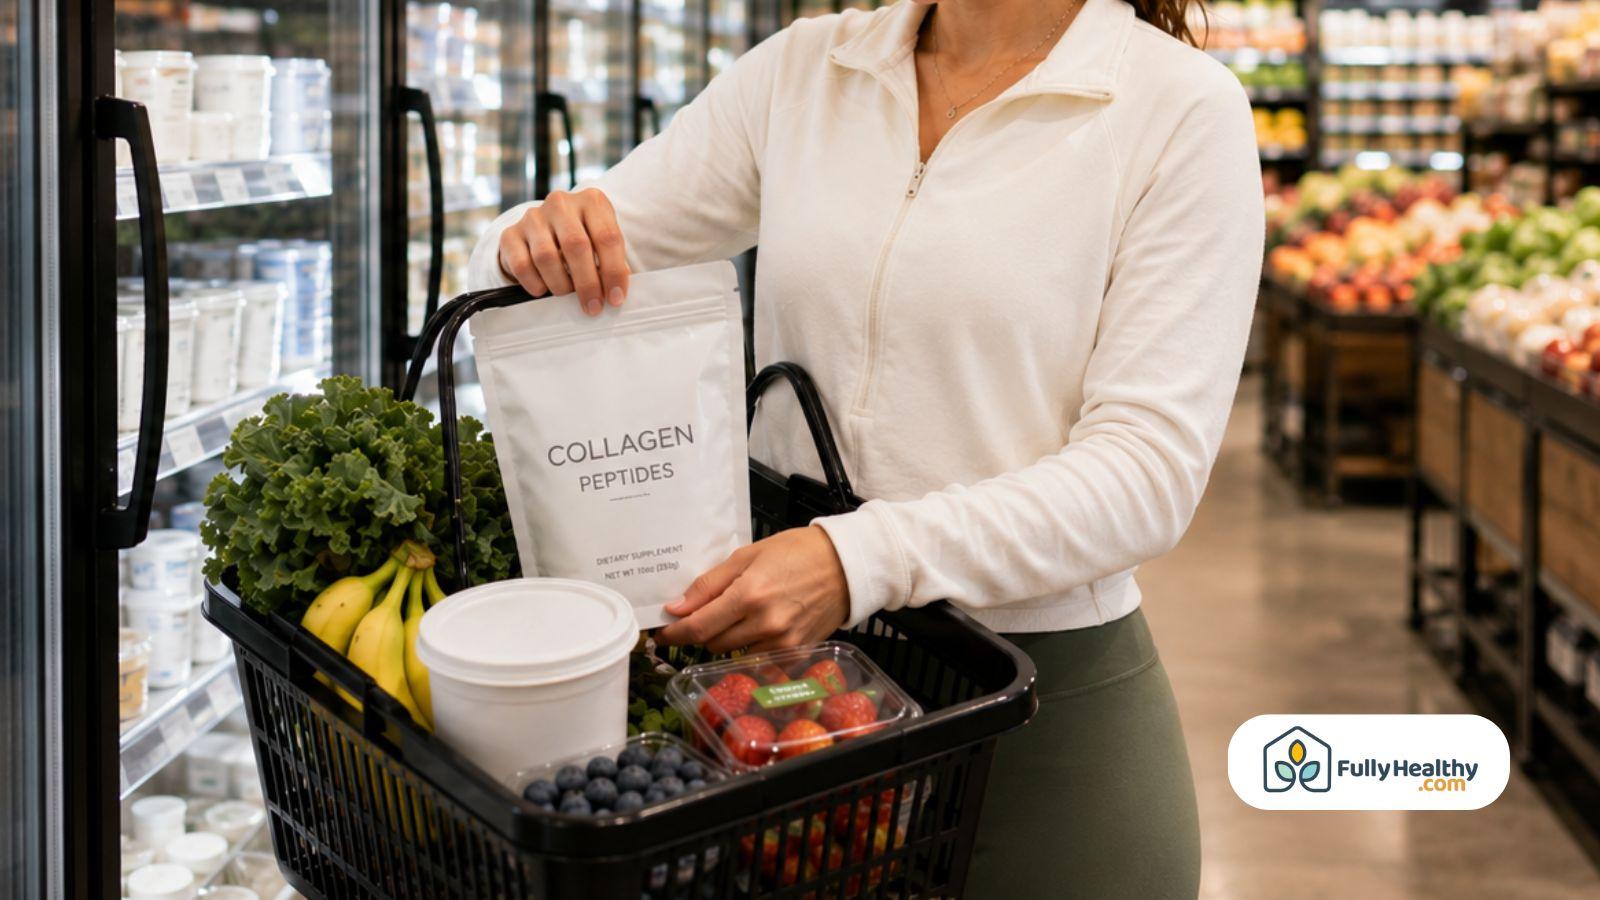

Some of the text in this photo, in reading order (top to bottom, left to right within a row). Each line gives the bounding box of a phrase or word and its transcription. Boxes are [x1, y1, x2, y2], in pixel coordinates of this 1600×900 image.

[548, 424, 694, 466] COLLAGEN
[579, 462, 674, 492] PEPTIDES
[596, 544, 683, 566] DIETARY SUPPLEMENT
[604, 571, 621, 580] NET
[623, 568, 635, 577] WT
